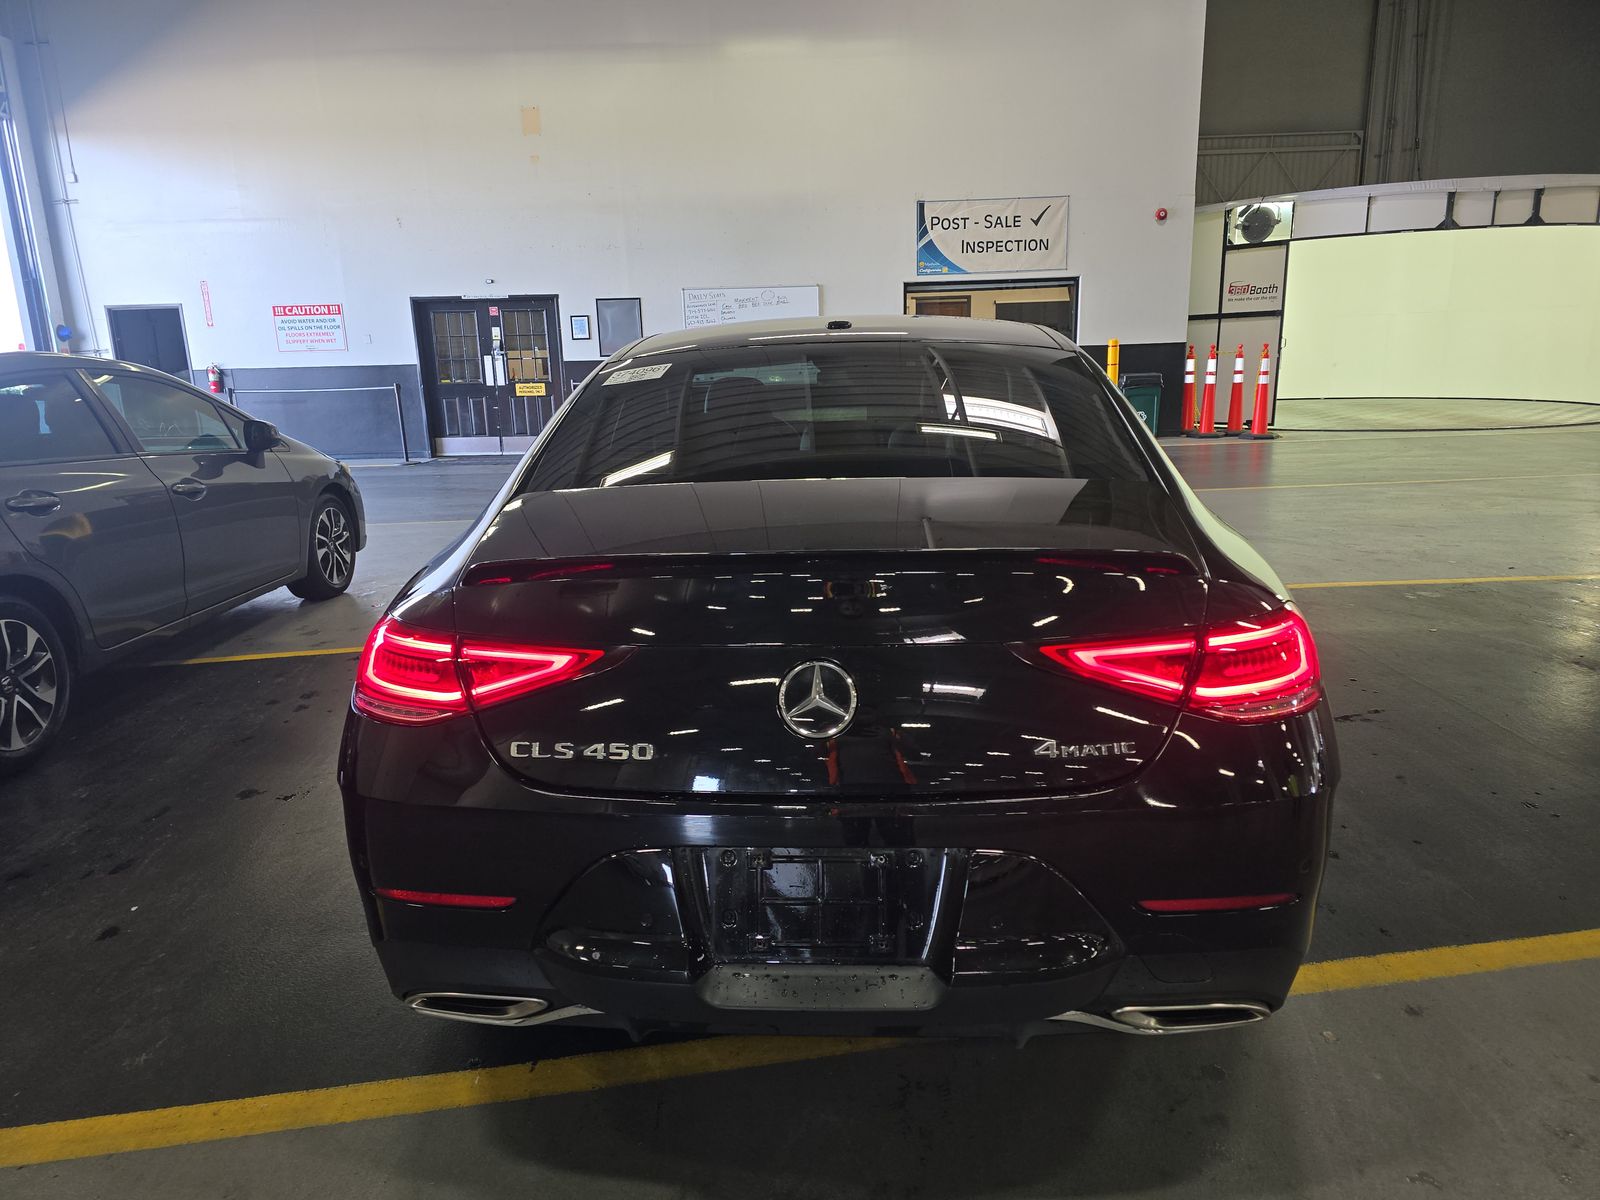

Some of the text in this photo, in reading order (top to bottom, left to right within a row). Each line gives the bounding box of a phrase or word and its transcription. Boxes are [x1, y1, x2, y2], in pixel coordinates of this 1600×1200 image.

[961, 238, 1049, 254] INSPECTION
[285, 305, 328, 315] CAUTION
[510, 741, 654, 760] CLS 450
[1033, 740, 1137, 758] 4MATIC
